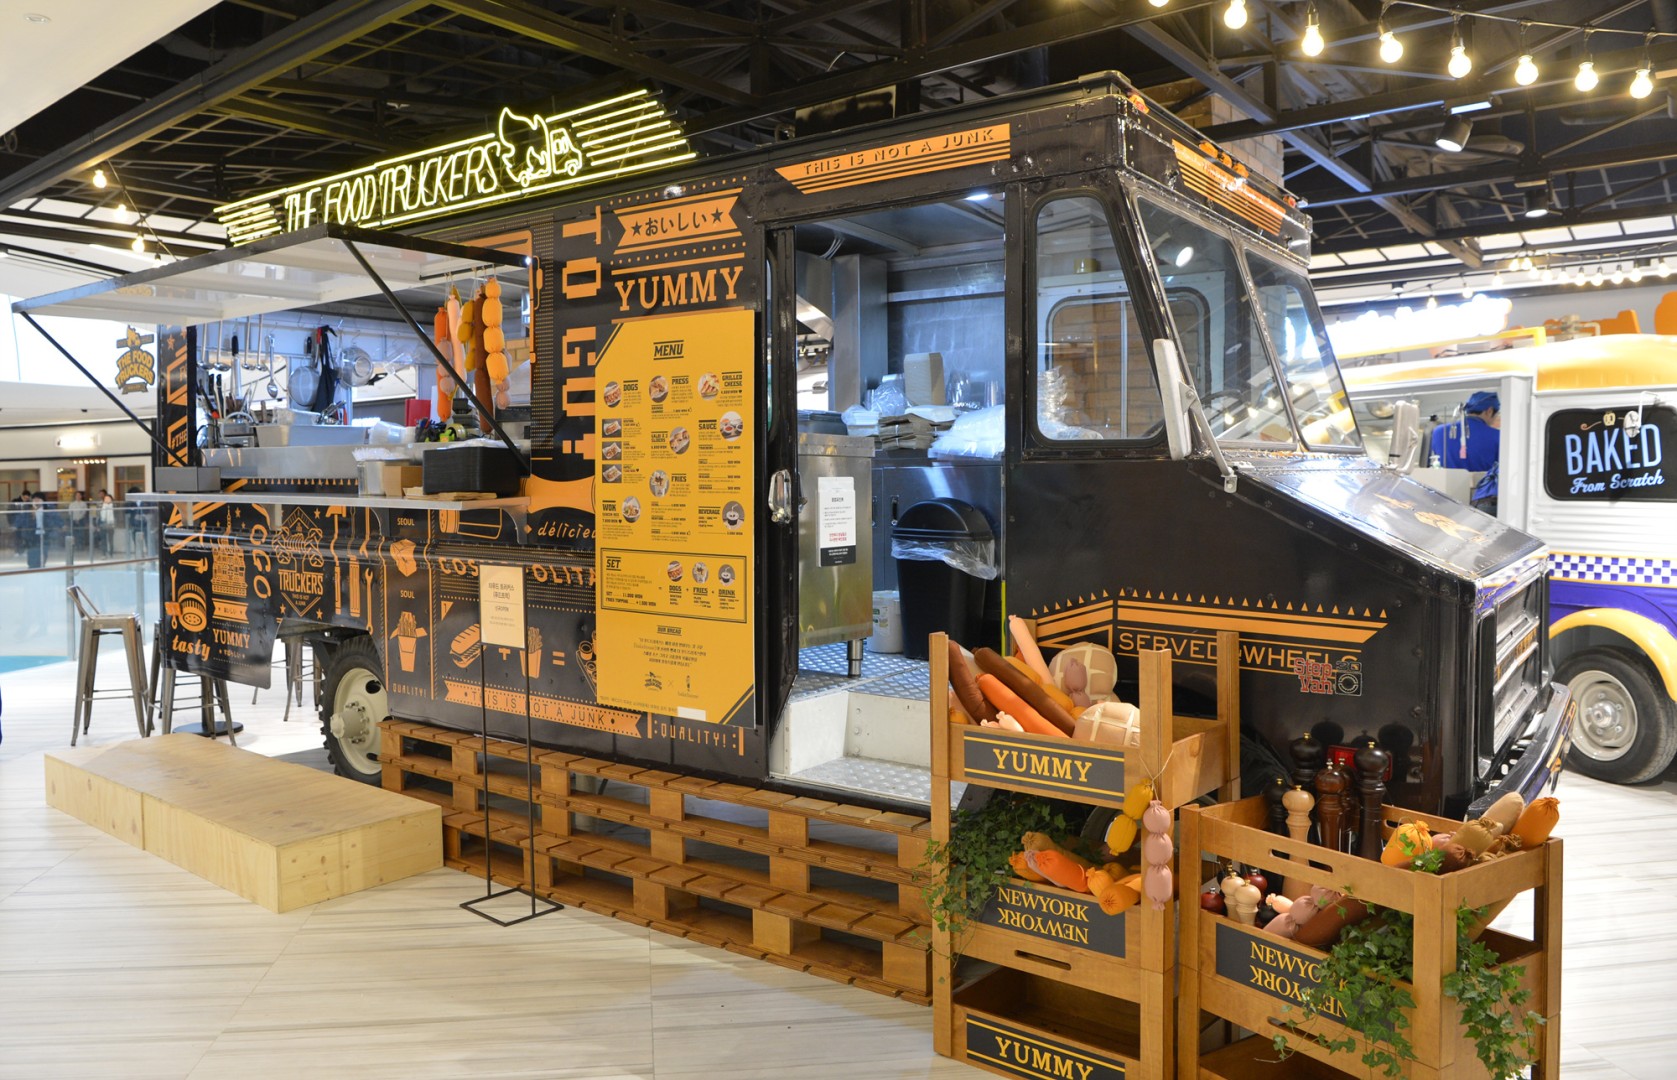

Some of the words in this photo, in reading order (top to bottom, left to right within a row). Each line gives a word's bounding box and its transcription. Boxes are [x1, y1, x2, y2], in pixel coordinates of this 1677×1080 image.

[803, 157, 841, 175] THIS
[850, 153, 865, 166] IS
[874, 144, 911, 162] NOT
[920, 141, 932, 153] A
[942, 128, 994, 149] JUNK
[285, 186, 322, 233] THE
[324, 175, 377, 226] FOOD
[379, 141, 501, 216] TRUCKERS
[644, 210, 708, 237] おいしい
[615, 266, 744, 311] YUMMY
[117, 351, 131, 370] THE
[132, 350, 154, 369] FOOD
[653, 343, 684, 357] MENU
[116, 364, 155, 388] TRUCKERS
[623, 383, 639, 392] DOGS
[721, 374, 743, 382] GRILLED
[698, 423, 717, 431] SAUCE
[1565, 423, 1662, 476] BAKED
[671, 475, 687, 483] FRIES
[1570, 477, 1606, 494] From
[1609, 469, 1665, 489] Scratch
[602, 503, 617, 512] WOK
[397, 517, 415, 526] SEOUL
[606, 558, 622, 569] SET
[278, 571, 324, 596] TRUCKERS
[400, 590, 415, 599] SOUL
[172, 635, 211, 661] tasty
[213, 628, 250, 649] YUMMY
[1294, 657, 1333, 680] Step
[392, 682, 427, 698] QUALITY!
[1299, 675, 1334, 695] Van
[506, 697, 517, 709] IS
[556, 704, 564, 716] A
[571, 707, 605, 725] JUNK
[993, 748, 1092, 782] YUMMY
[998, 886, 1089, 922] NEWYORK
[998, 907, 1089, 944] NEWYORK
[995, 1035, 1094, 1080] YUMMY
